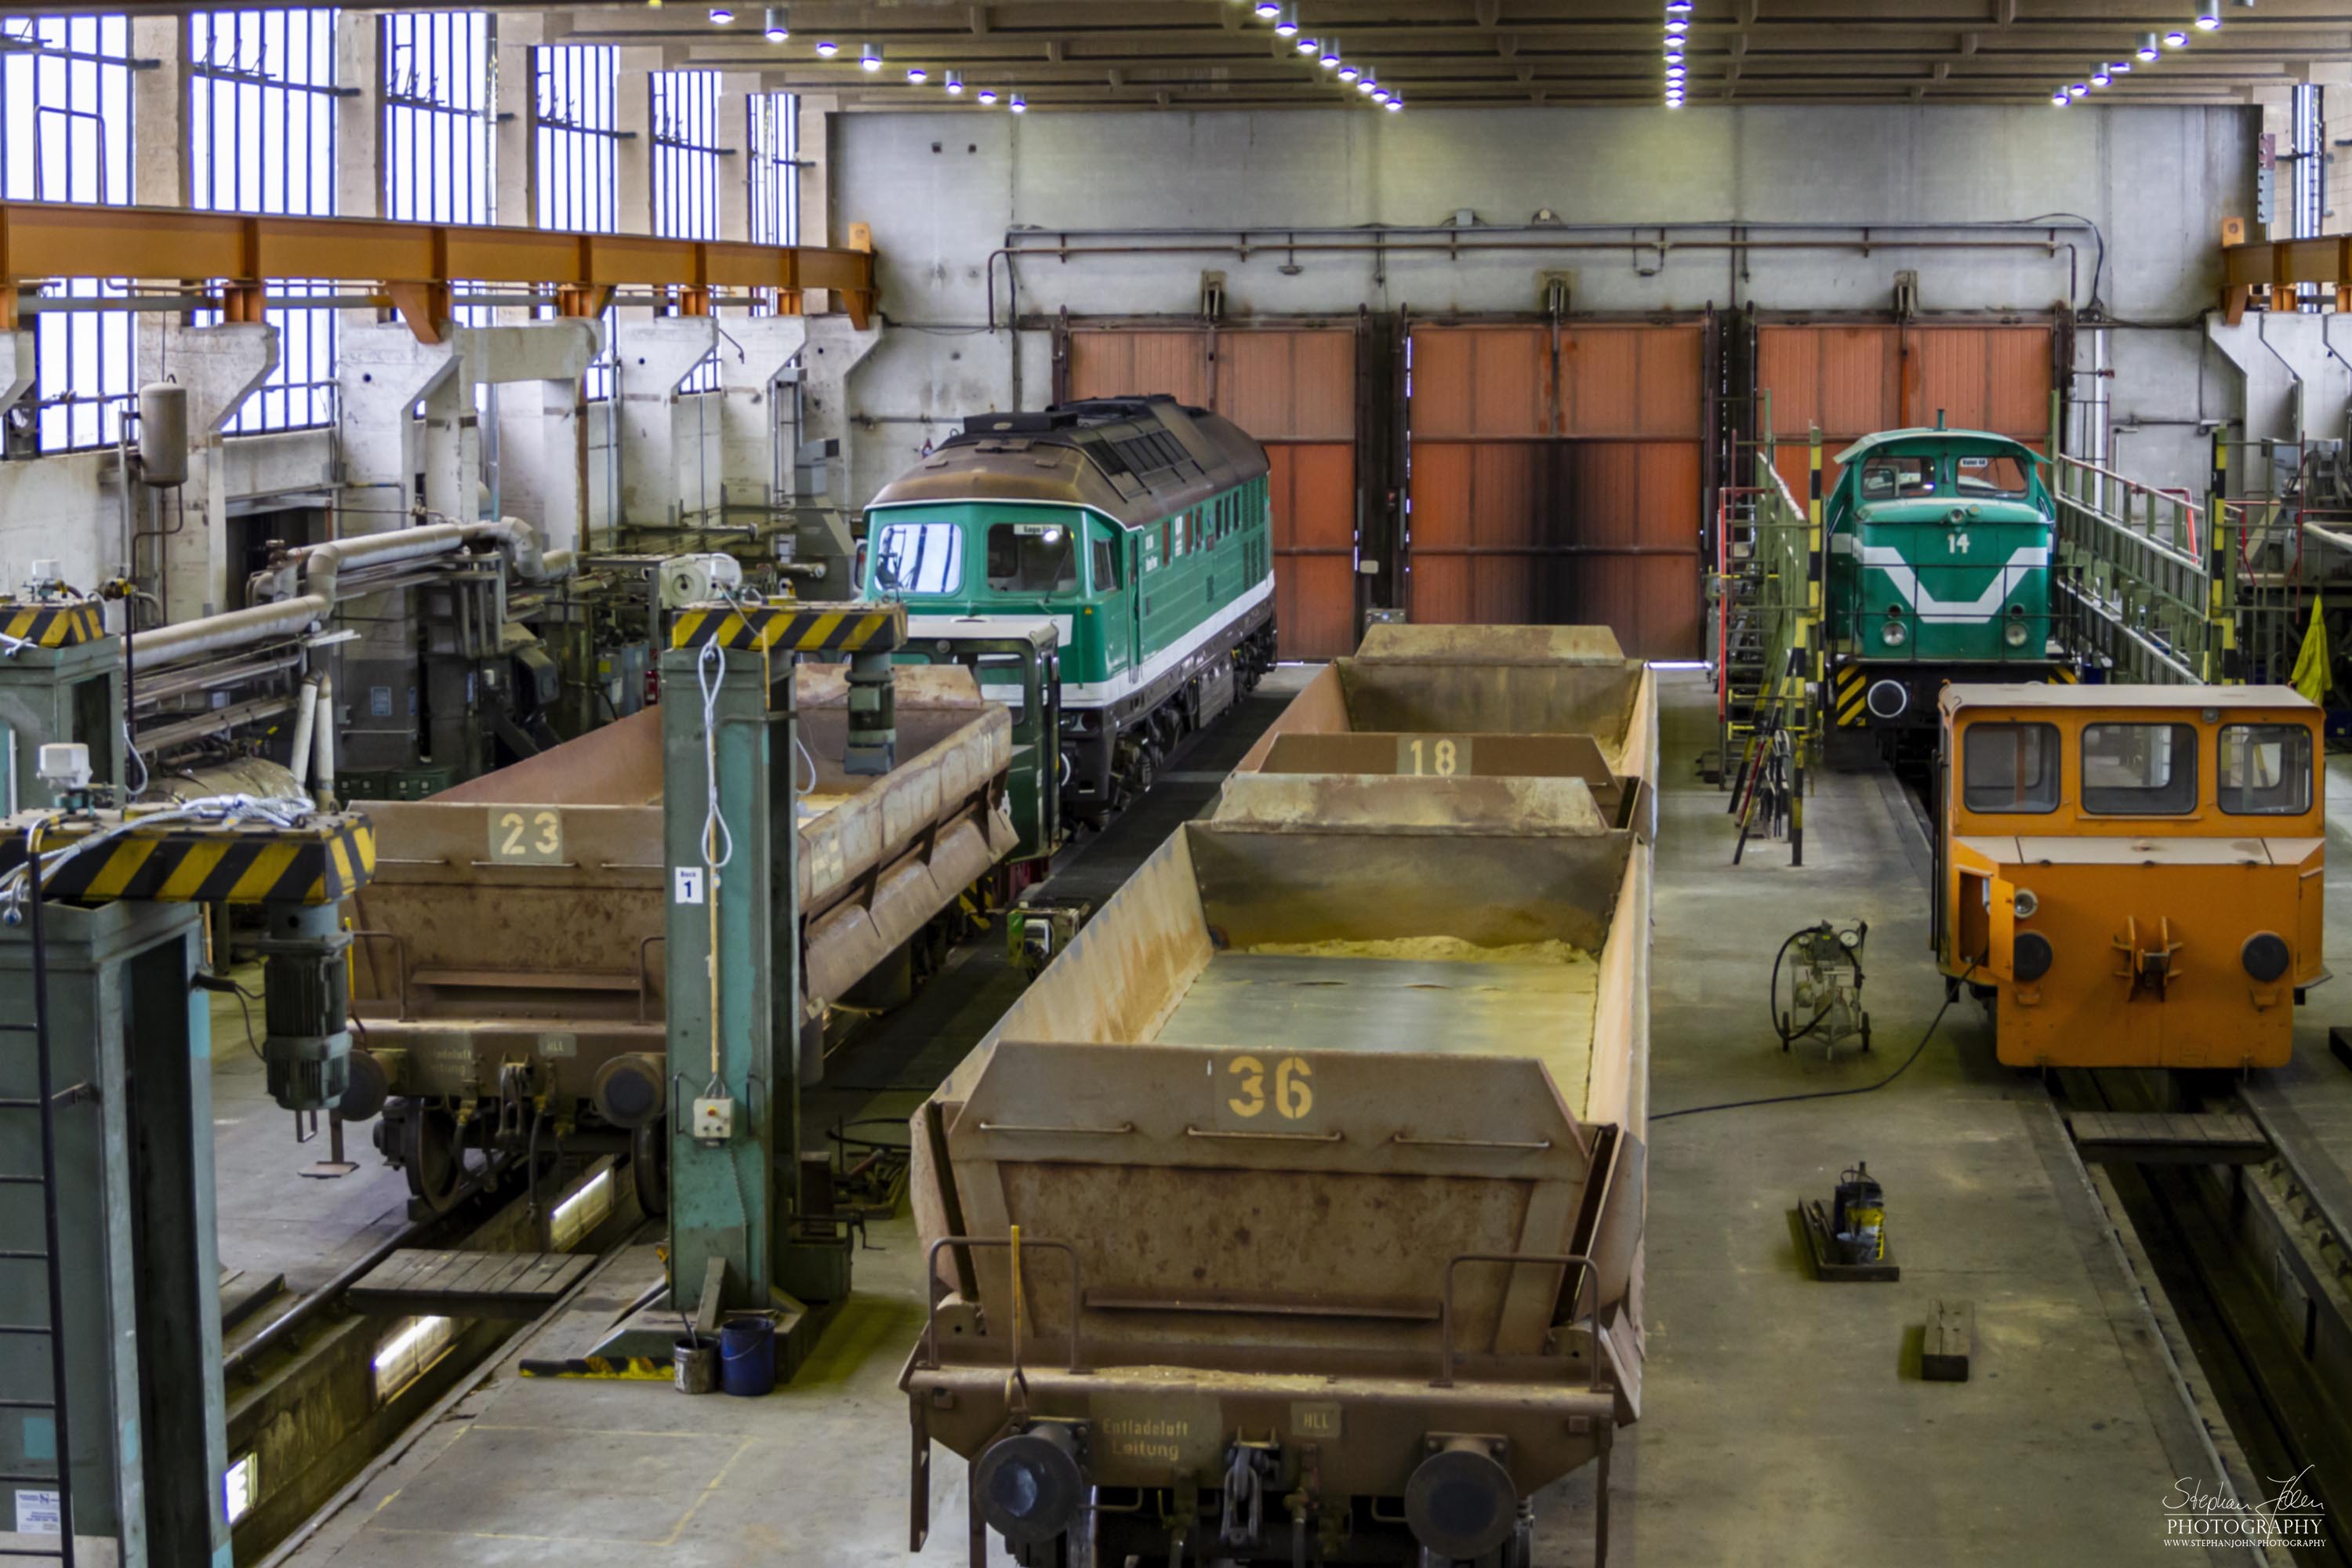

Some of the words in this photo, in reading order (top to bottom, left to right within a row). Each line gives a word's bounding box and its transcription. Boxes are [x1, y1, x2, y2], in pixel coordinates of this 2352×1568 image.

[1947, 533, 1970, 554] 14
[1410, 739, 1457, 778] 18
[501, 811, 559, 855] 23
[684, 880, 691, 898] 1
[1228, 1055, 1313, 1120] 36
[1102, 1417, 1189, 1436] Entladeluft
[1303, 1412, 1330, 1430] HLL
[1112, 1440, 1180, 1461] Leitung
